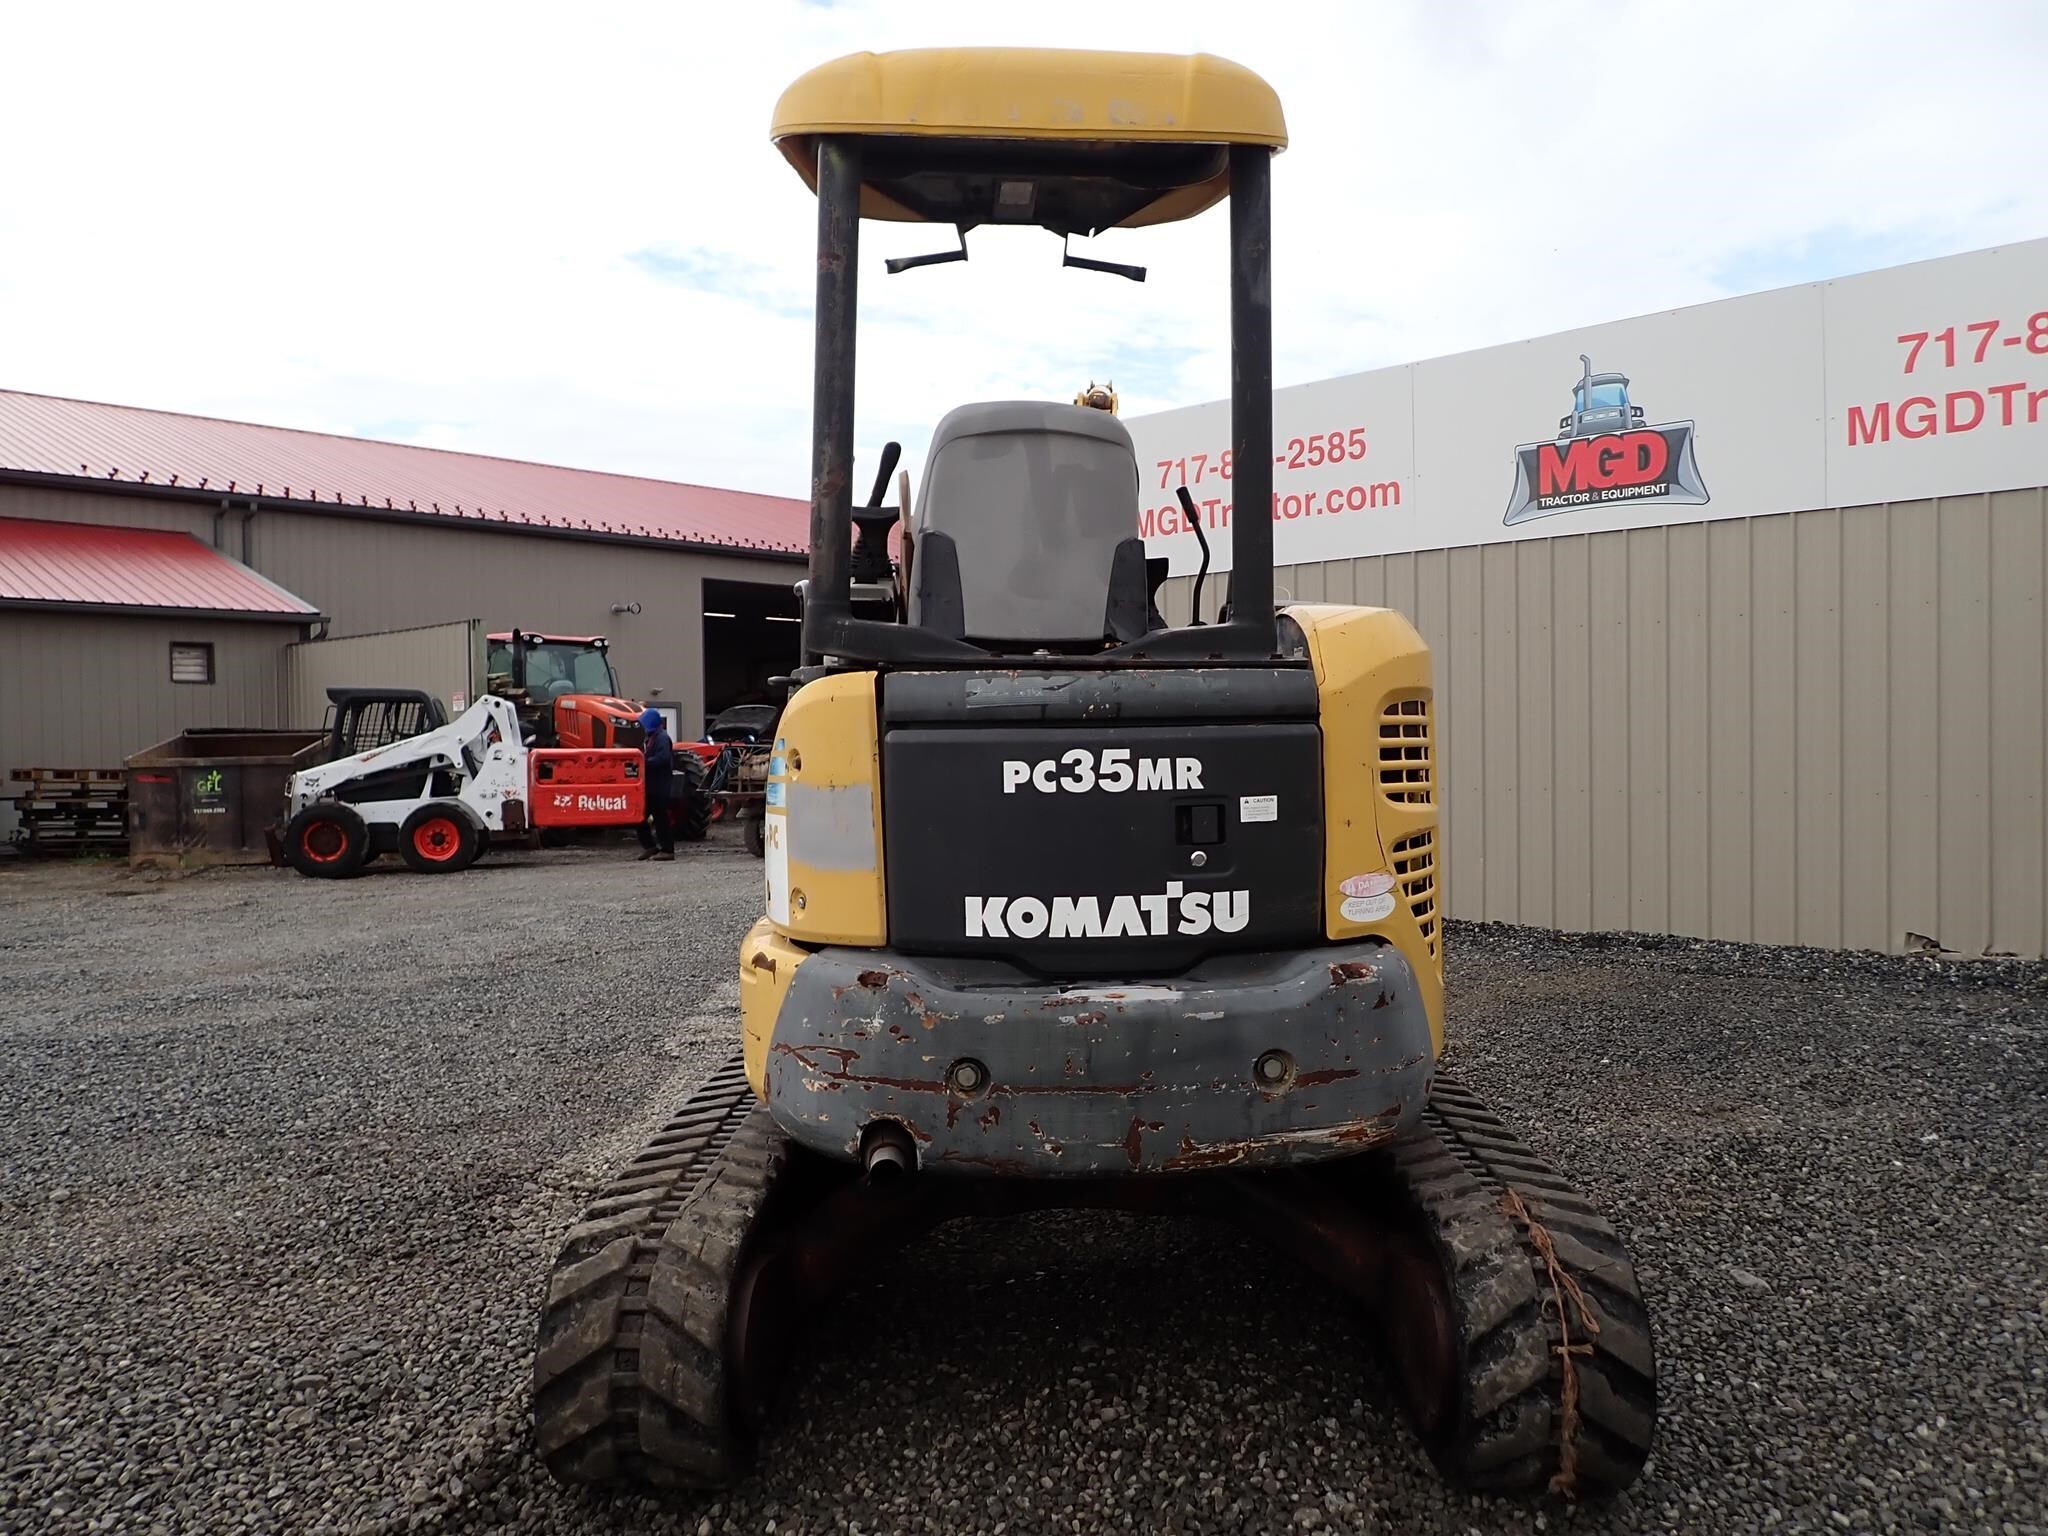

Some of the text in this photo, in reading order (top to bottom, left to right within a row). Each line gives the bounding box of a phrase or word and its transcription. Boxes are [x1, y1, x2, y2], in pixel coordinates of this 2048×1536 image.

[1897, 311, 2048, 374] 717-8
[1848, 382, 2048, 447] MGDTr
[1157, 428, 1367, 489] 717-8-2585
[1539, 430, 1668, 495] MGD
[1138, 480, 1401, 539] MGDTrtor.com
[1540, 483, 1667, 507] TRACTOR & EQUIPMENT
[197, 770, 222, 792] GFL
[1003, 748, 1205, 793] PC35MR
[578, 795, 627, 811] Bobcat
[965, 880, 1250, 939] KOMATSU
